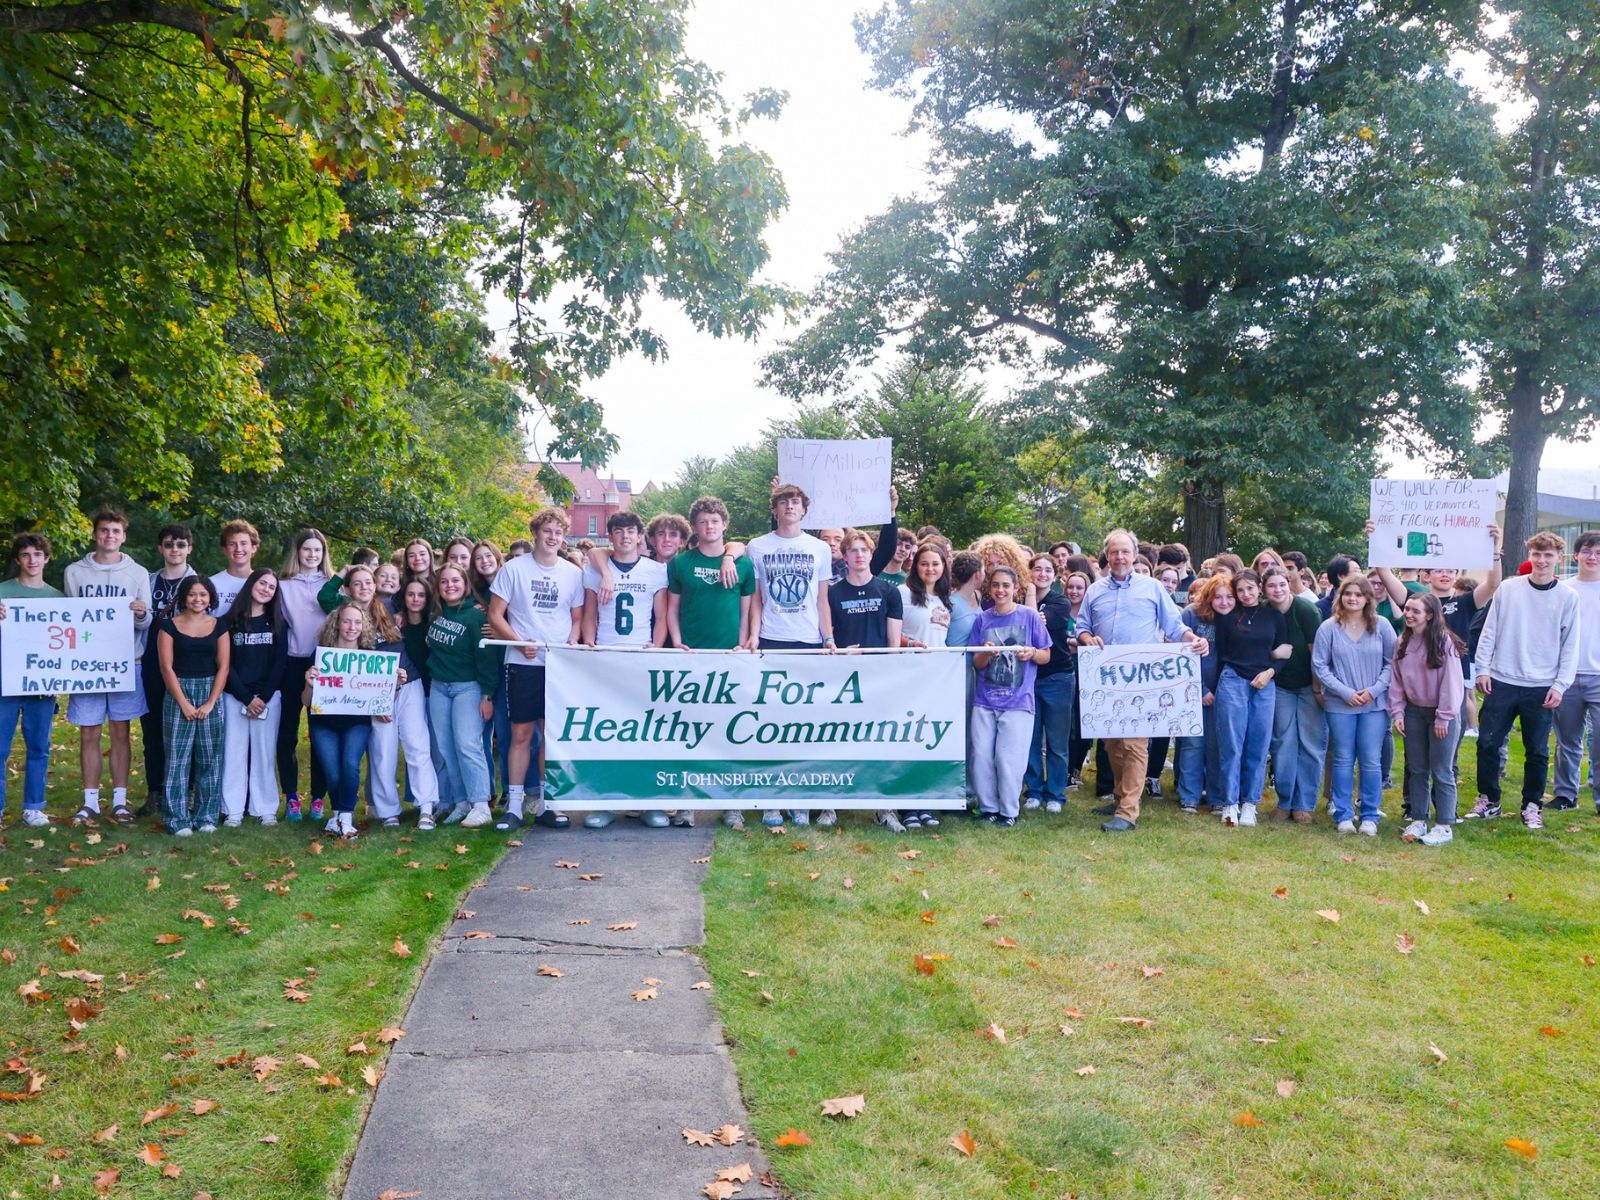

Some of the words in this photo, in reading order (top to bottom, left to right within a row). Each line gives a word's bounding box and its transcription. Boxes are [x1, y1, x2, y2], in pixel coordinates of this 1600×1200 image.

[793, 442, 824, 471] 47
[824, 452, 887, 472] Million
[1374, 480, 1398, 497] WE
[1404, 479, 1438, 498] WALK
[1377, 514, 1396, 526] ARE
[1400, 513, 1439, 528] FACING
[762, 553, 814, 583] YANKEES
[613, 583, 647, 592] LTOPPERS
[10, 606, 72, 622] There
[81, 607, 116, 622] Are
[615, 592, 634, 635] 6
[847, 606, 879, 614] ATHLETICS
[26, 653, 62, 670] Food
[320, 651, 397, 675] SUPPORT
[1099, 655, 1194, 686] HUNGER
[315, 676, 344, 688] THE
[647, 669, 741, 705] Walk
[751, 669, 825, 705] For
[831, 669, 864, 705] A
[556, 706, 715, 750] Healthy
[724, 709, 954, 750] Community
[681, 770, 774, 788] JOHNSBURY
[775, 771, 856, 787] ACADEMY
